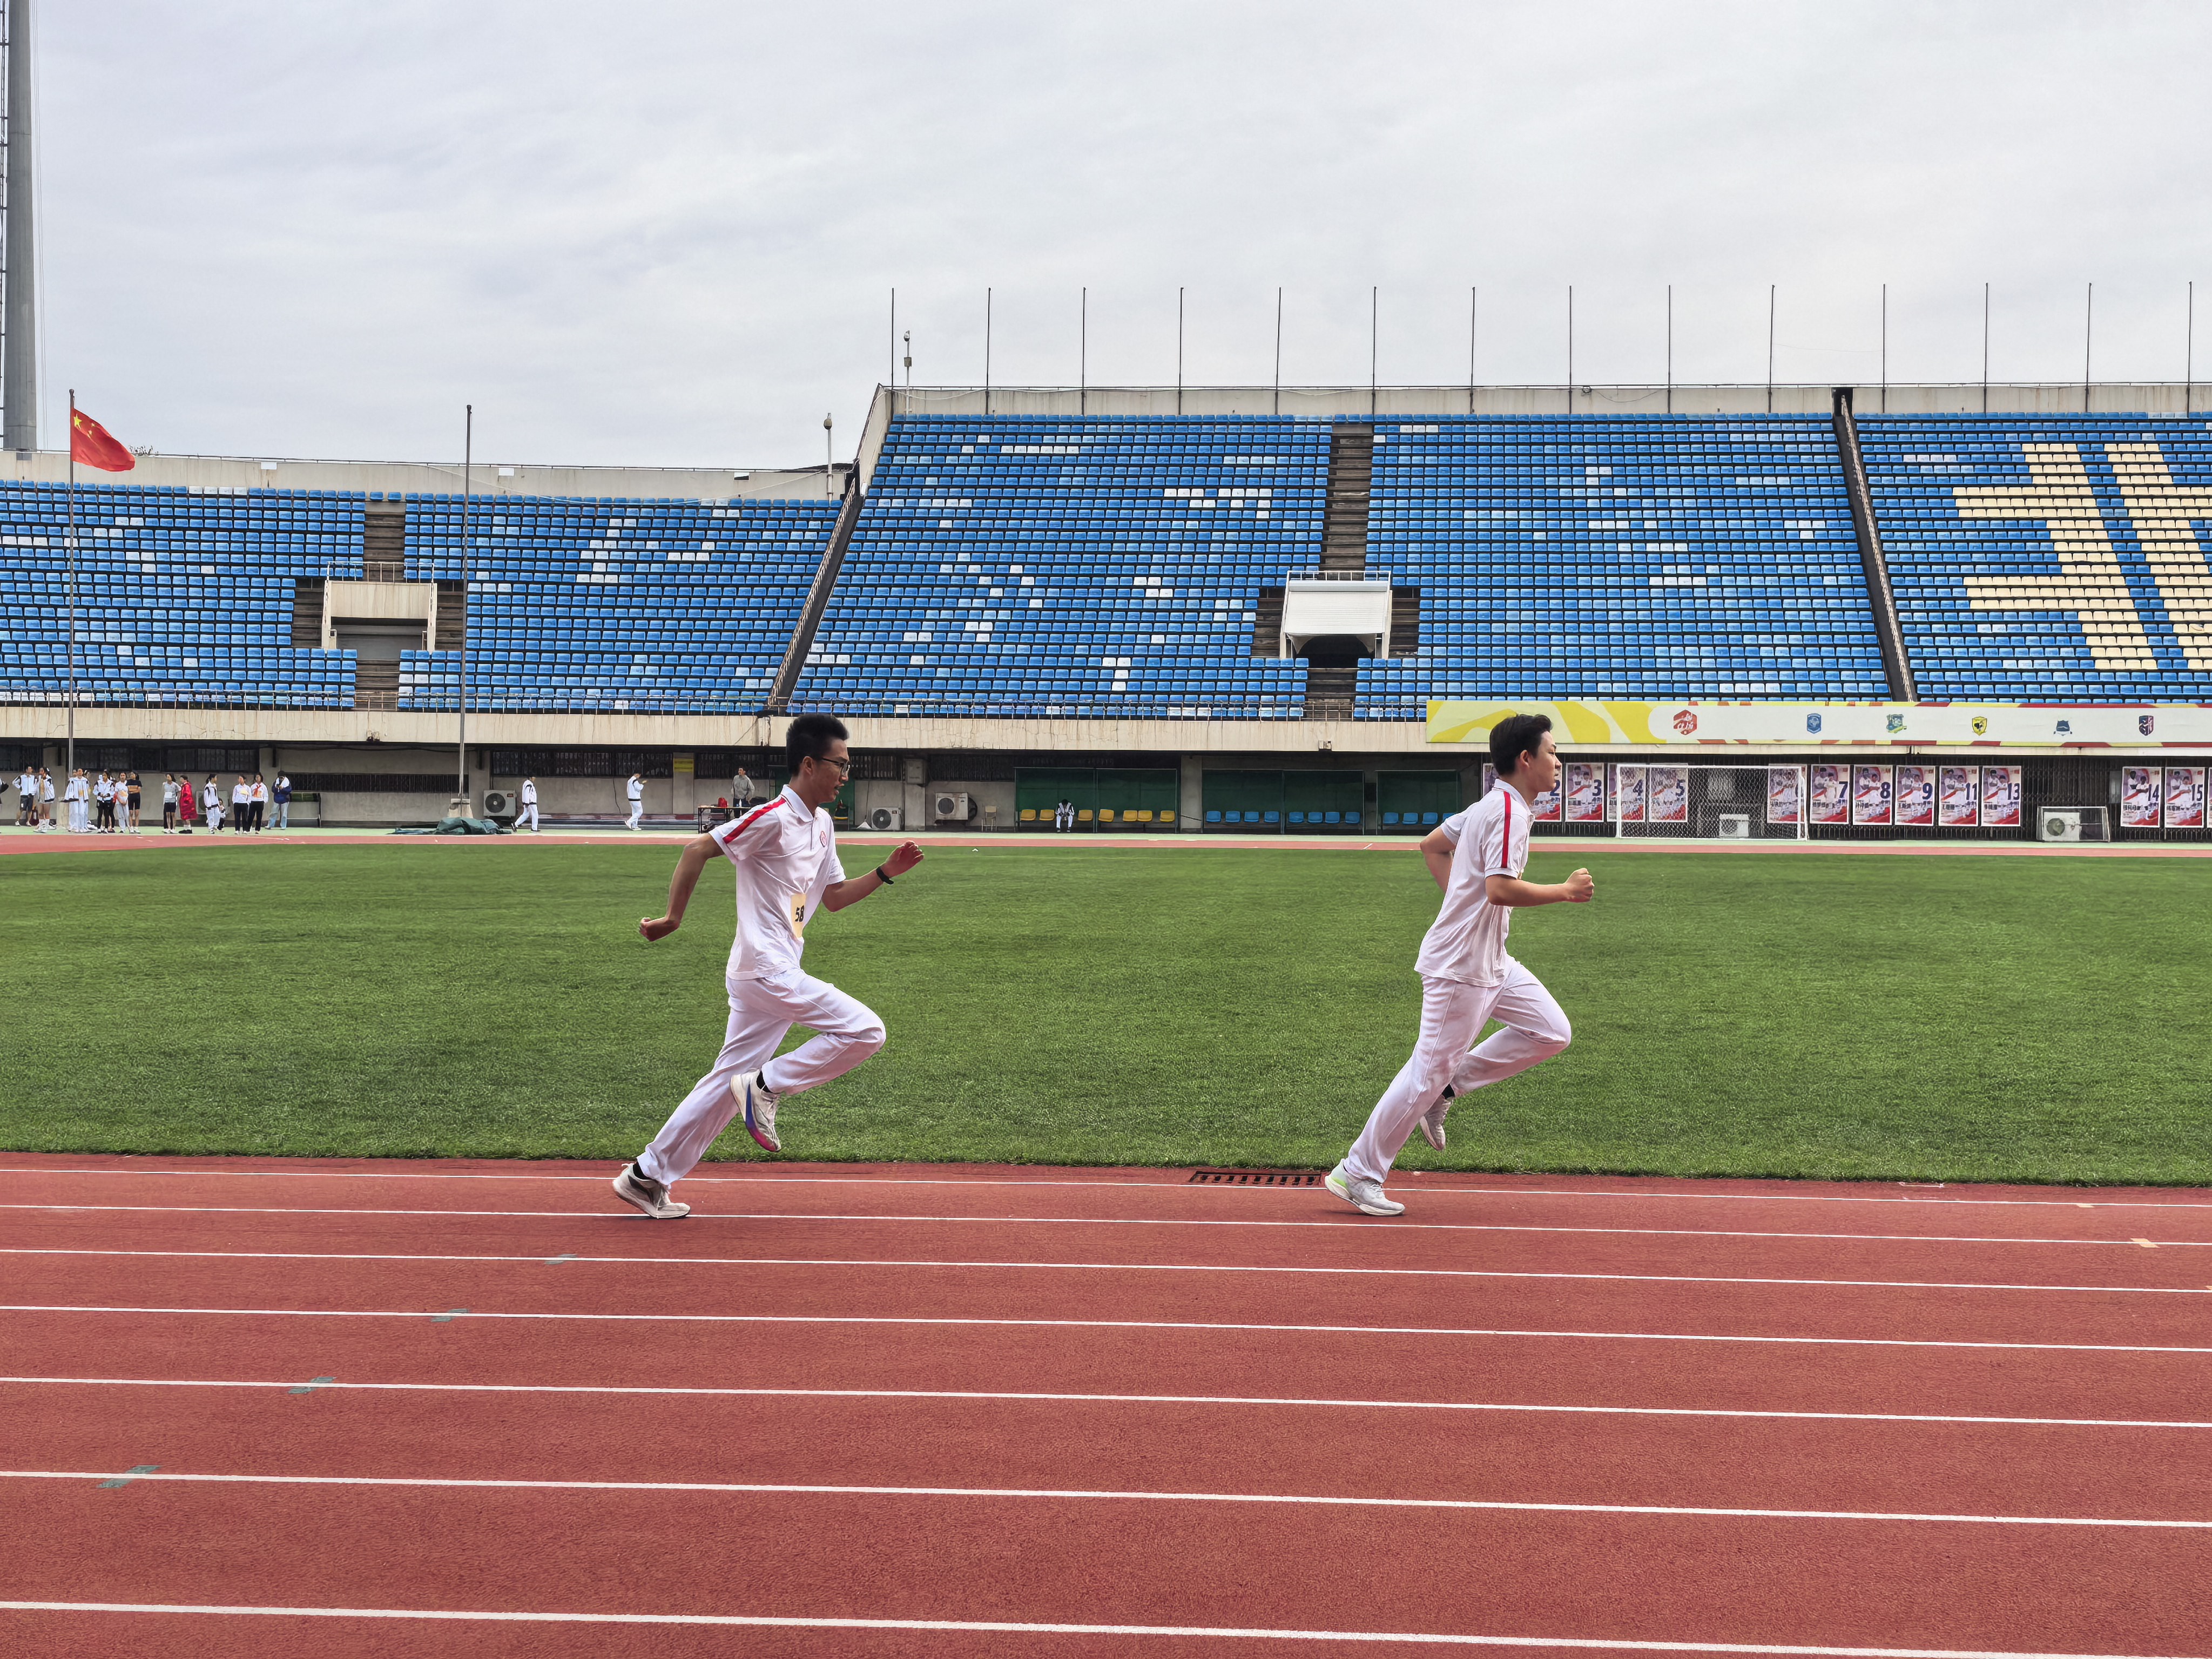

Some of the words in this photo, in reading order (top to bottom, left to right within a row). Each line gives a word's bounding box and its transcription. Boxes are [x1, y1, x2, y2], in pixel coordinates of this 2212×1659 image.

[1550, 779, 1560, 796] 2
[1592, 779, 1602, 796] 3
[1633, 779, 1643, 797] 4
[1676, 779, 1685, 797] 5
[1838, 781, 1848, 798] 7
[1880, 781, 1891, 799] 8
[1922, 783, 1933, 800] 9
[1966, 783, 1977, 800] 11
[2008, 783, 2020, 800] 13
[2148, 784, 2160, 801] 14
[2191, 784, 2203, 801] 15
[795, 905, 804, 922] 58
